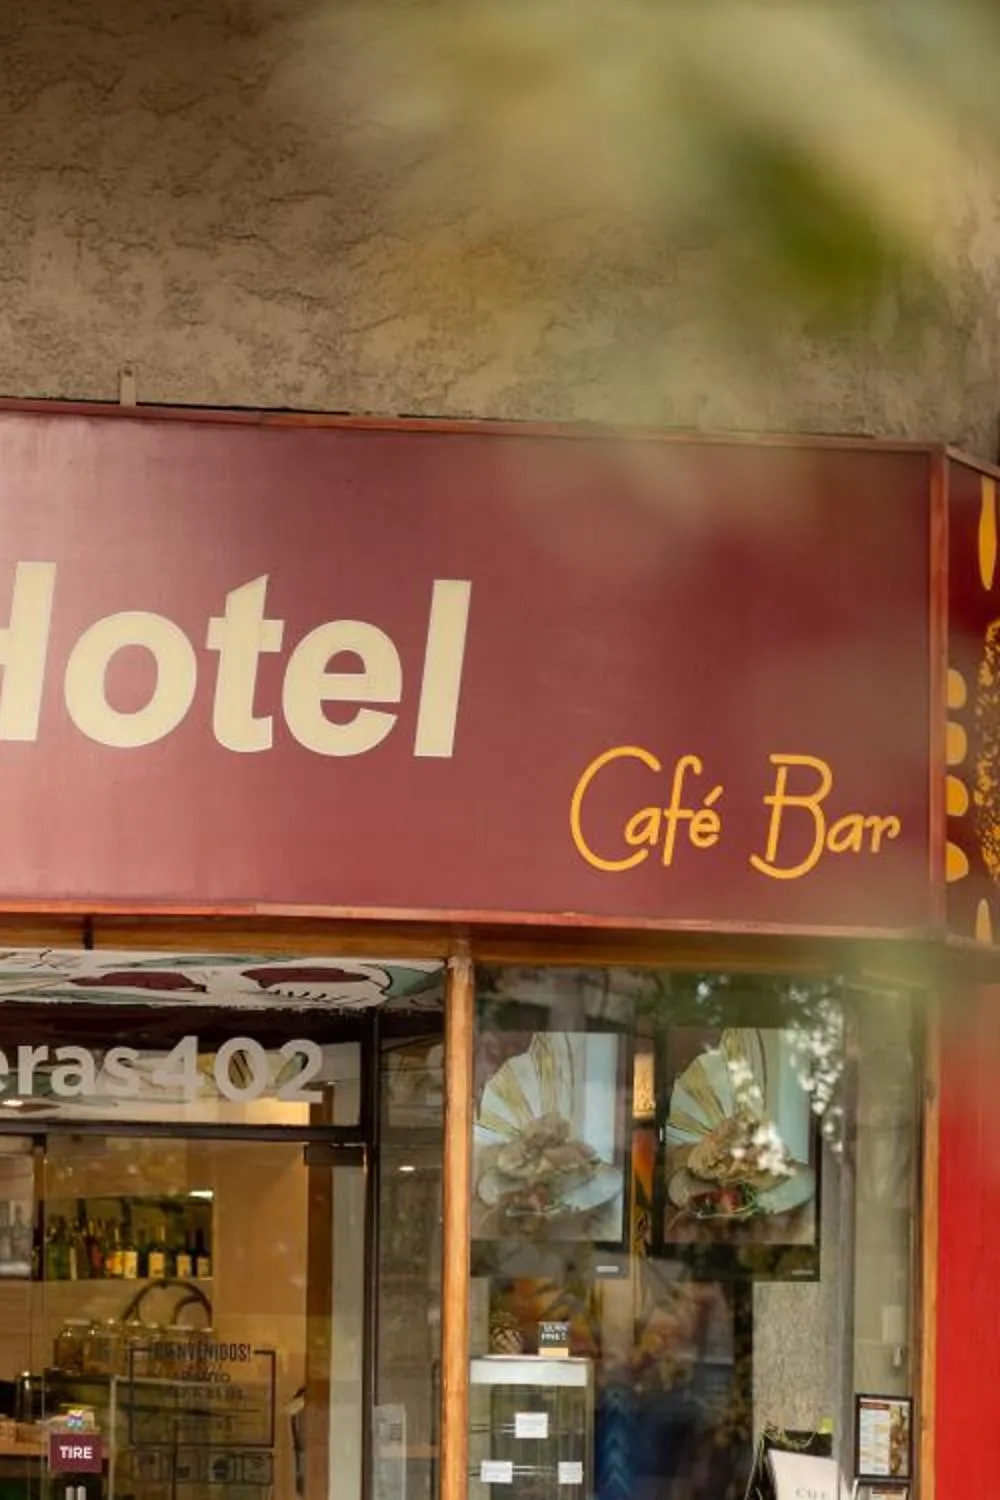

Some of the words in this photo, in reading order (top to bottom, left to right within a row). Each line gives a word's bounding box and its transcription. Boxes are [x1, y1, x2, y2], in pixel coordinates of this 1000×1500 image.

[570, 746, 723, 871] Café
[750, 753, 900, 879] Bar
[59, 1445, 93, 1459] TIRE
